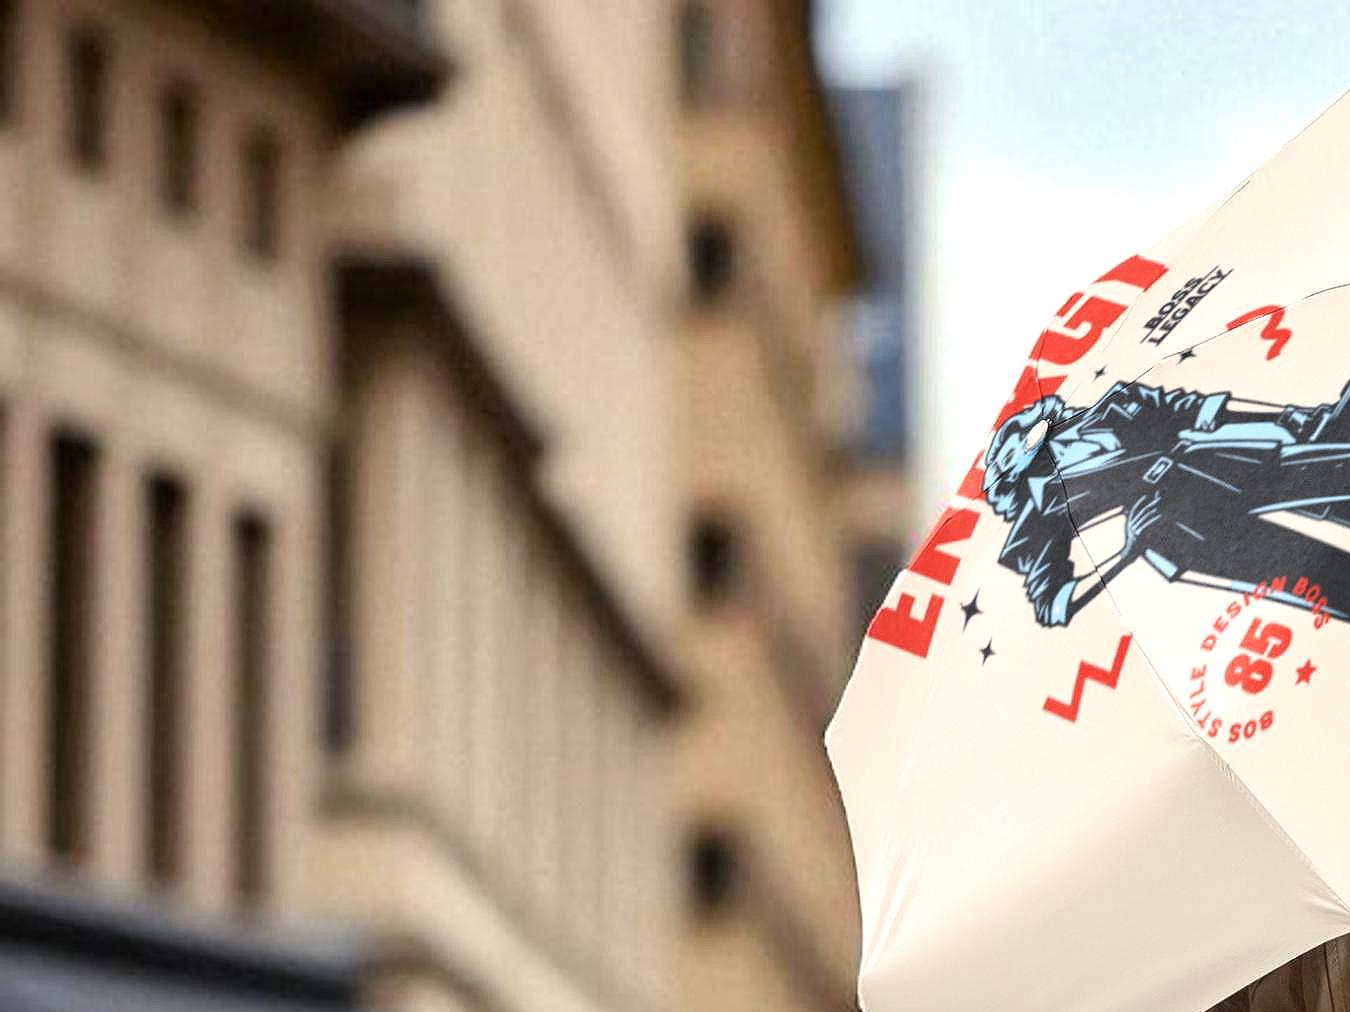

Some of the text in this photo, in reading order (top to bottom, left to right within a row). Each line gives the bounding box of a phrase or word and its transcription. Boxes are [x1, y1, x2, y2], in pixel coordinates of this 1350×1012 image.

[1144, 277, 1203, 329] BOSS
[1148, 269, 1225, 346] LEGACY
[1190, 576, 1332, 744] BOS STYLE DESIGN BOSS
[1224, 616, 1293, 695] 85
